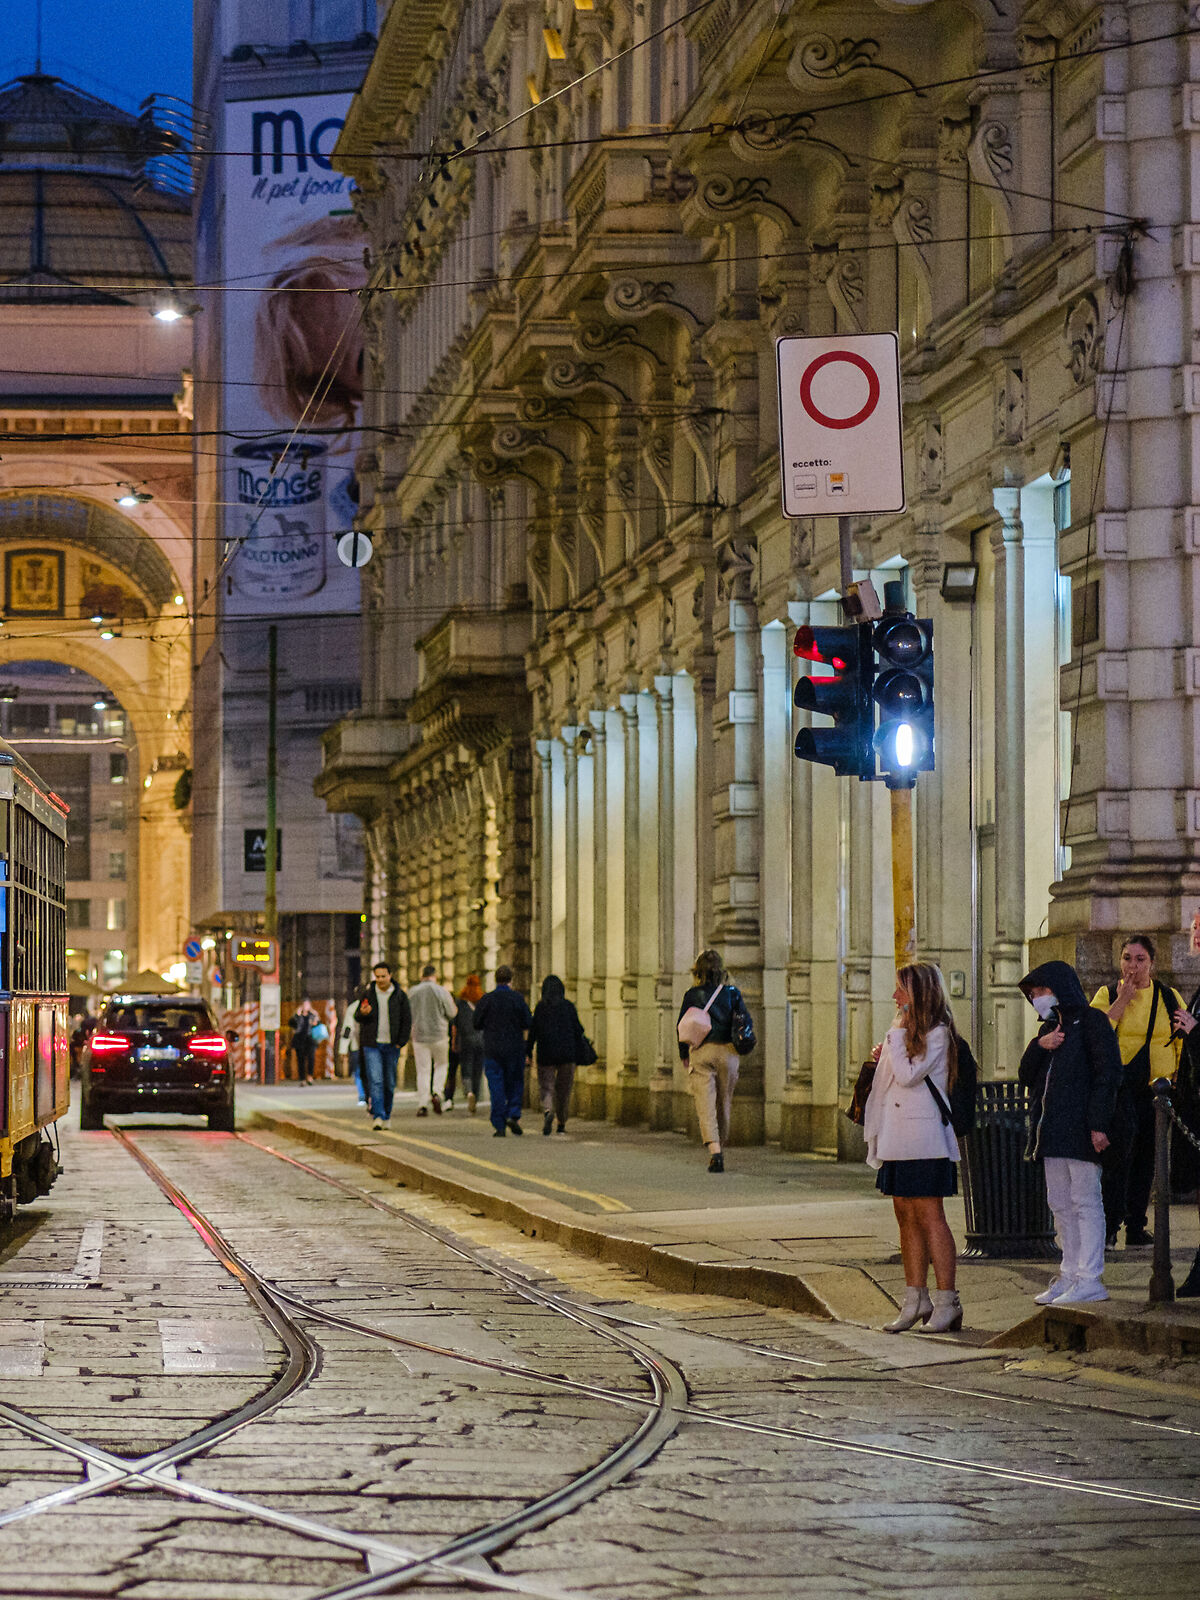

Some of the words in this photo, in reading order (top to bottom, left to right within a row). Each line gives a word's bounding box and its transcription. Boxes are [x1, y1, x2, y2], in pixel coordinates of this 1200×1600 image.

[266, 178, 299, 204] pet
[299, 177, 345, 204] food
[792, 459, 832, 468] eccetto:
